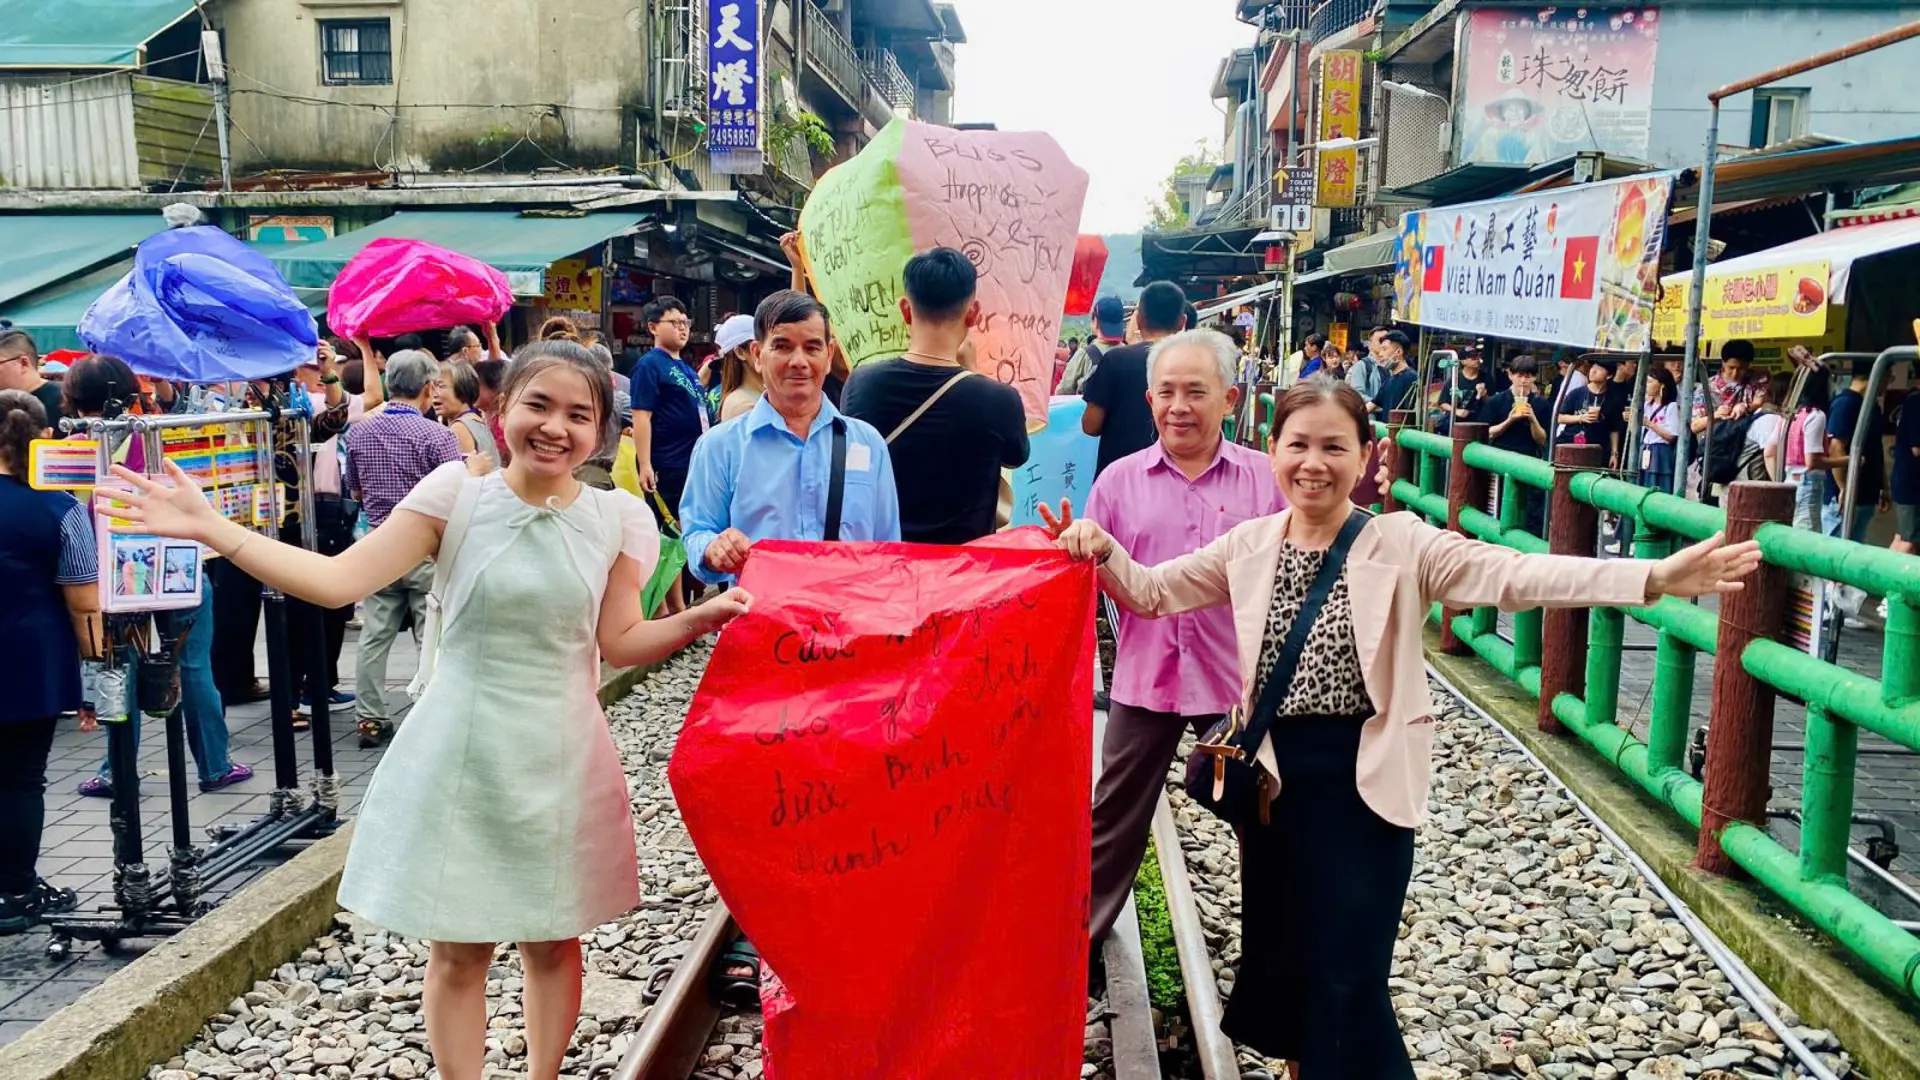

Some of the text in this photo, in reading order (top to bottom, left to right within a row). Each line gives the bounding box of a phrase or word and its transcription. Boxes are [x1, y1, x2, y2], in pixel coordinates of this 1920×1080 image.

[713, 3, 754, 105] 天燈
[711, 128, 755, 146] 24958850
[923, 137, 1043, 172] BLISS
[1475, 266, 1507, 296] Nam
